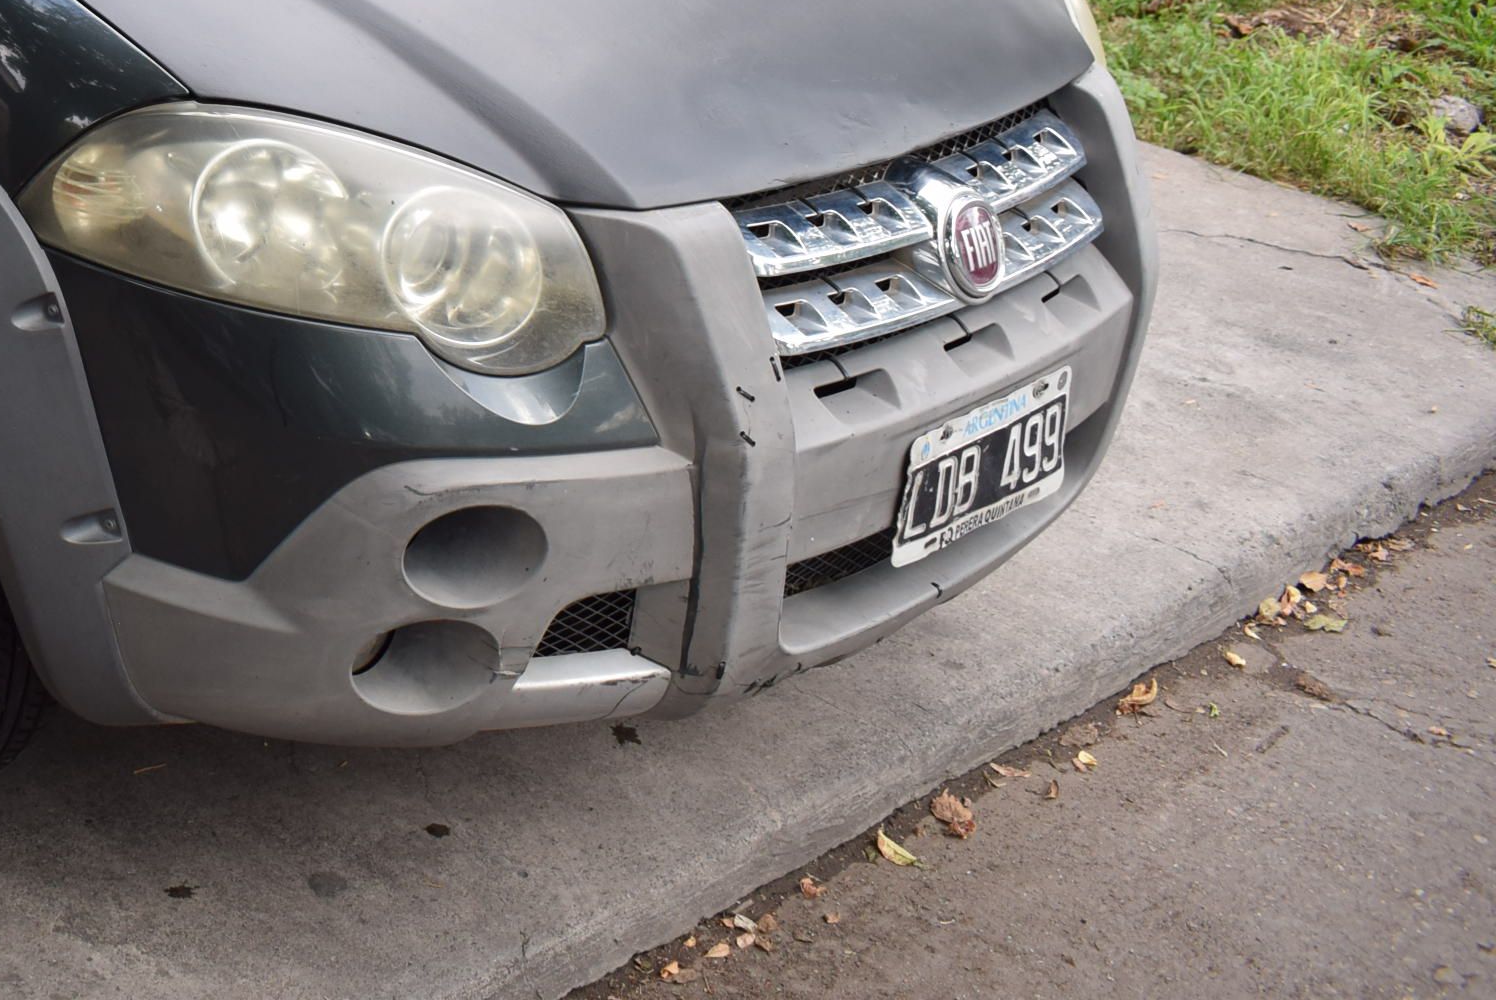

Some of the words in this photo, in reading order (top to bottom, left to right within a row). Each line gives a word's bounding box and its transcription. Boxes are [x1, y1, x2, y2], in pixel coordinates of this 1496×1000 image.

[961, 220, 996, 272] FIAT
[964, 393, 1027, 436] ARGENTINA
[903, 446, 982, 539] LDB
[1000, 403, 1063, 490] 499
[955, 512, 983, 539] PERERA
[984, 493, 1025, 522] QUINTANA
